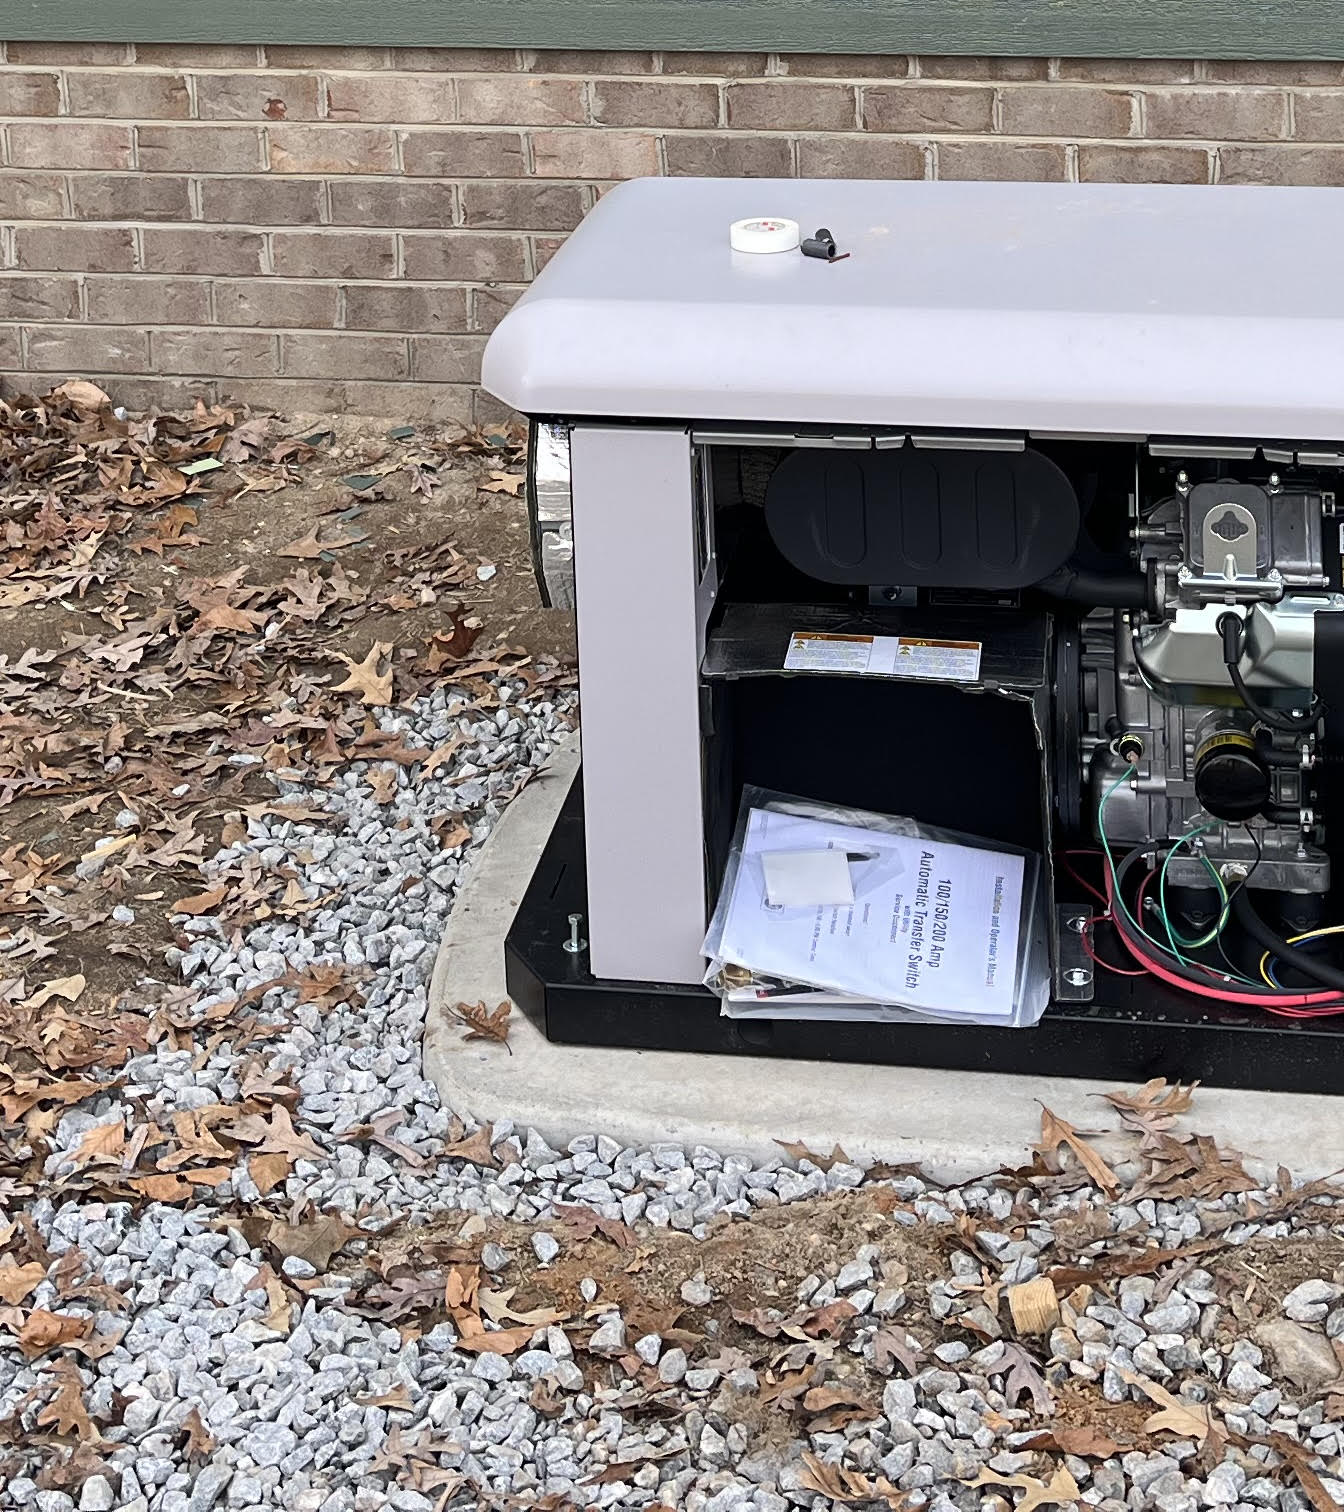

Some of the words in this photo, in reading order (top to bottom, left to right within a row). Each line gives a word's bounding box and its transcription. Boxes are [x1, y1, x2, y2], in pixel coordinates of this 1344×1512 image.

[915, 850, 935, 908] Automatic
[931, 879, 952, 943] 100/150/200
[991, 915, 1000, 928] and
[910, 910, 929, 952] Transfer
[905, 954, 923, 990] Switch
[926, 944, 944, 969] Amp
